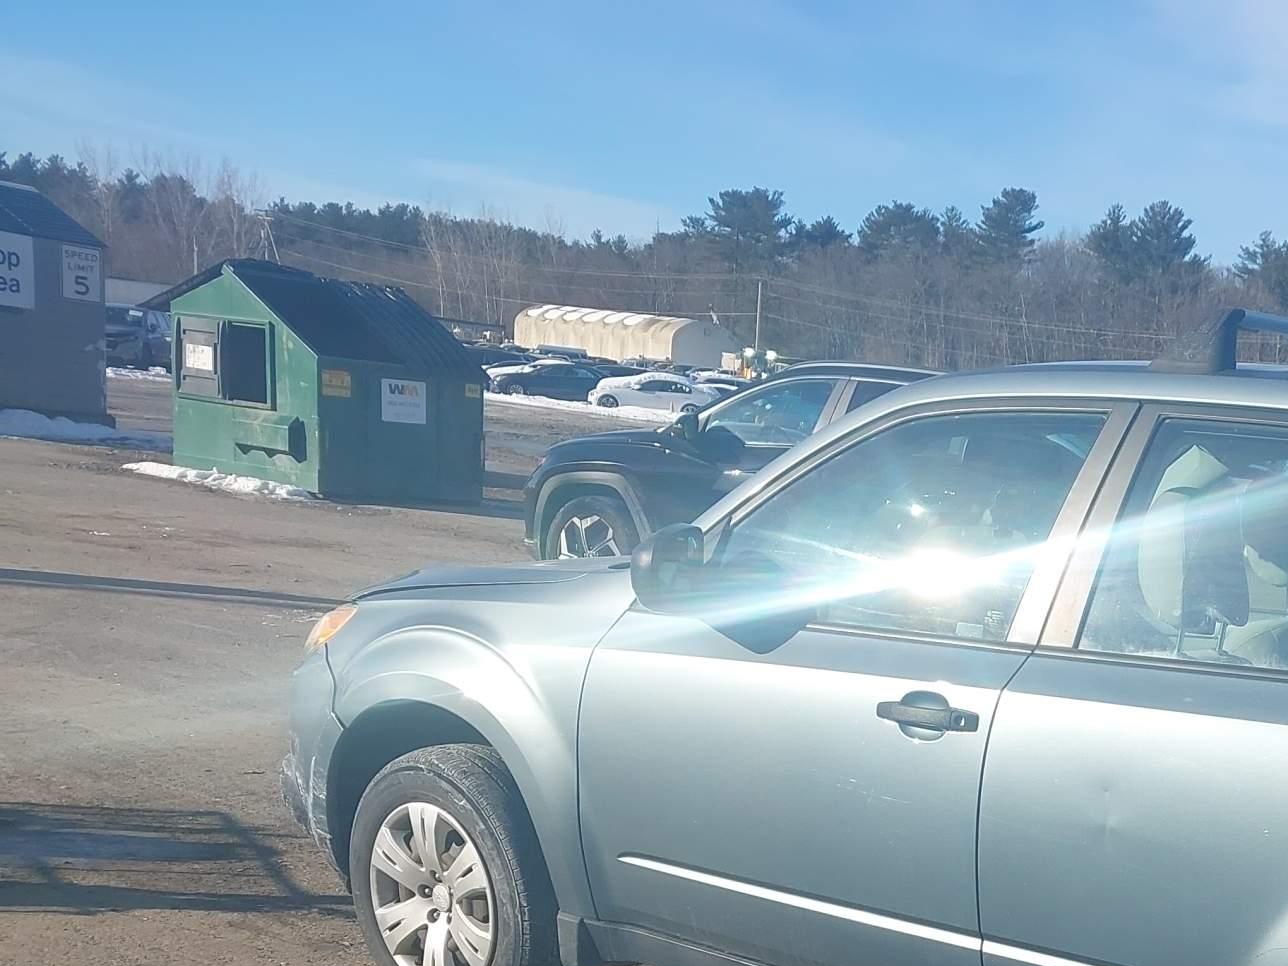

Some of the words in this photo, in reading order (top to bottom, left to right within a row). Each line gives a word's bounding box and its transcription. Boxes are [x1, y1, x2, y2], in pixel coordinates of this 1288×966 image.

[64, 249, 99, 263] SPEED
[67, 262, 95, 274] LIMIT
[74, 275, 90, 297] 5
[388, 383, 419, 397] WM
